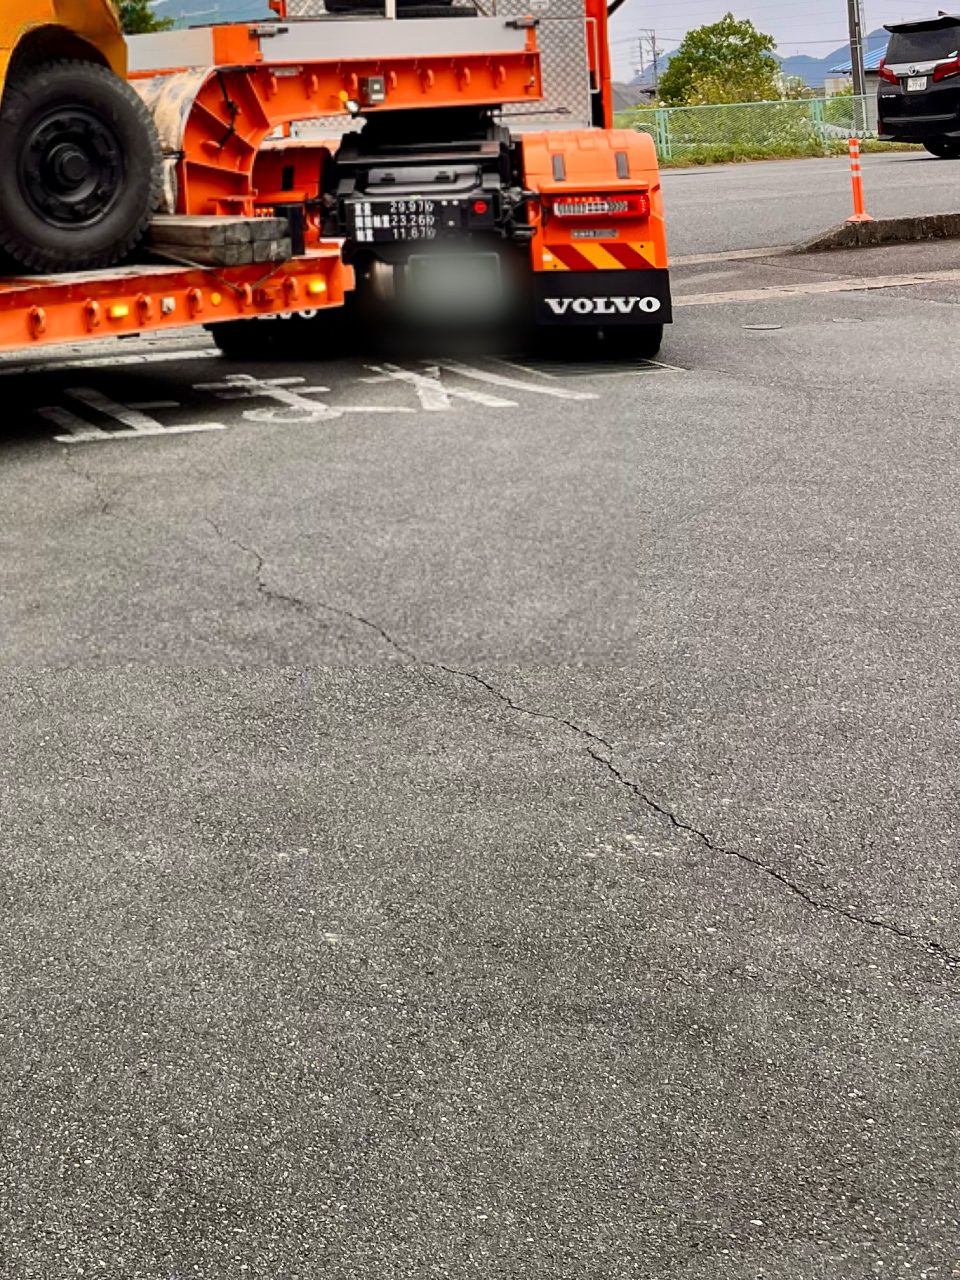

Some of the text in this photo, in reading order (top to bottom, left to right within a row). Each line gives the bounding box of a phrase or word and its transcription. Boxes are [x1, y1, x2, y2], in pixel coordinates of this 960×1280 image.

[544, 296, 661, 314] VOLVO
[37, 360, 601, 444] 止まれ
